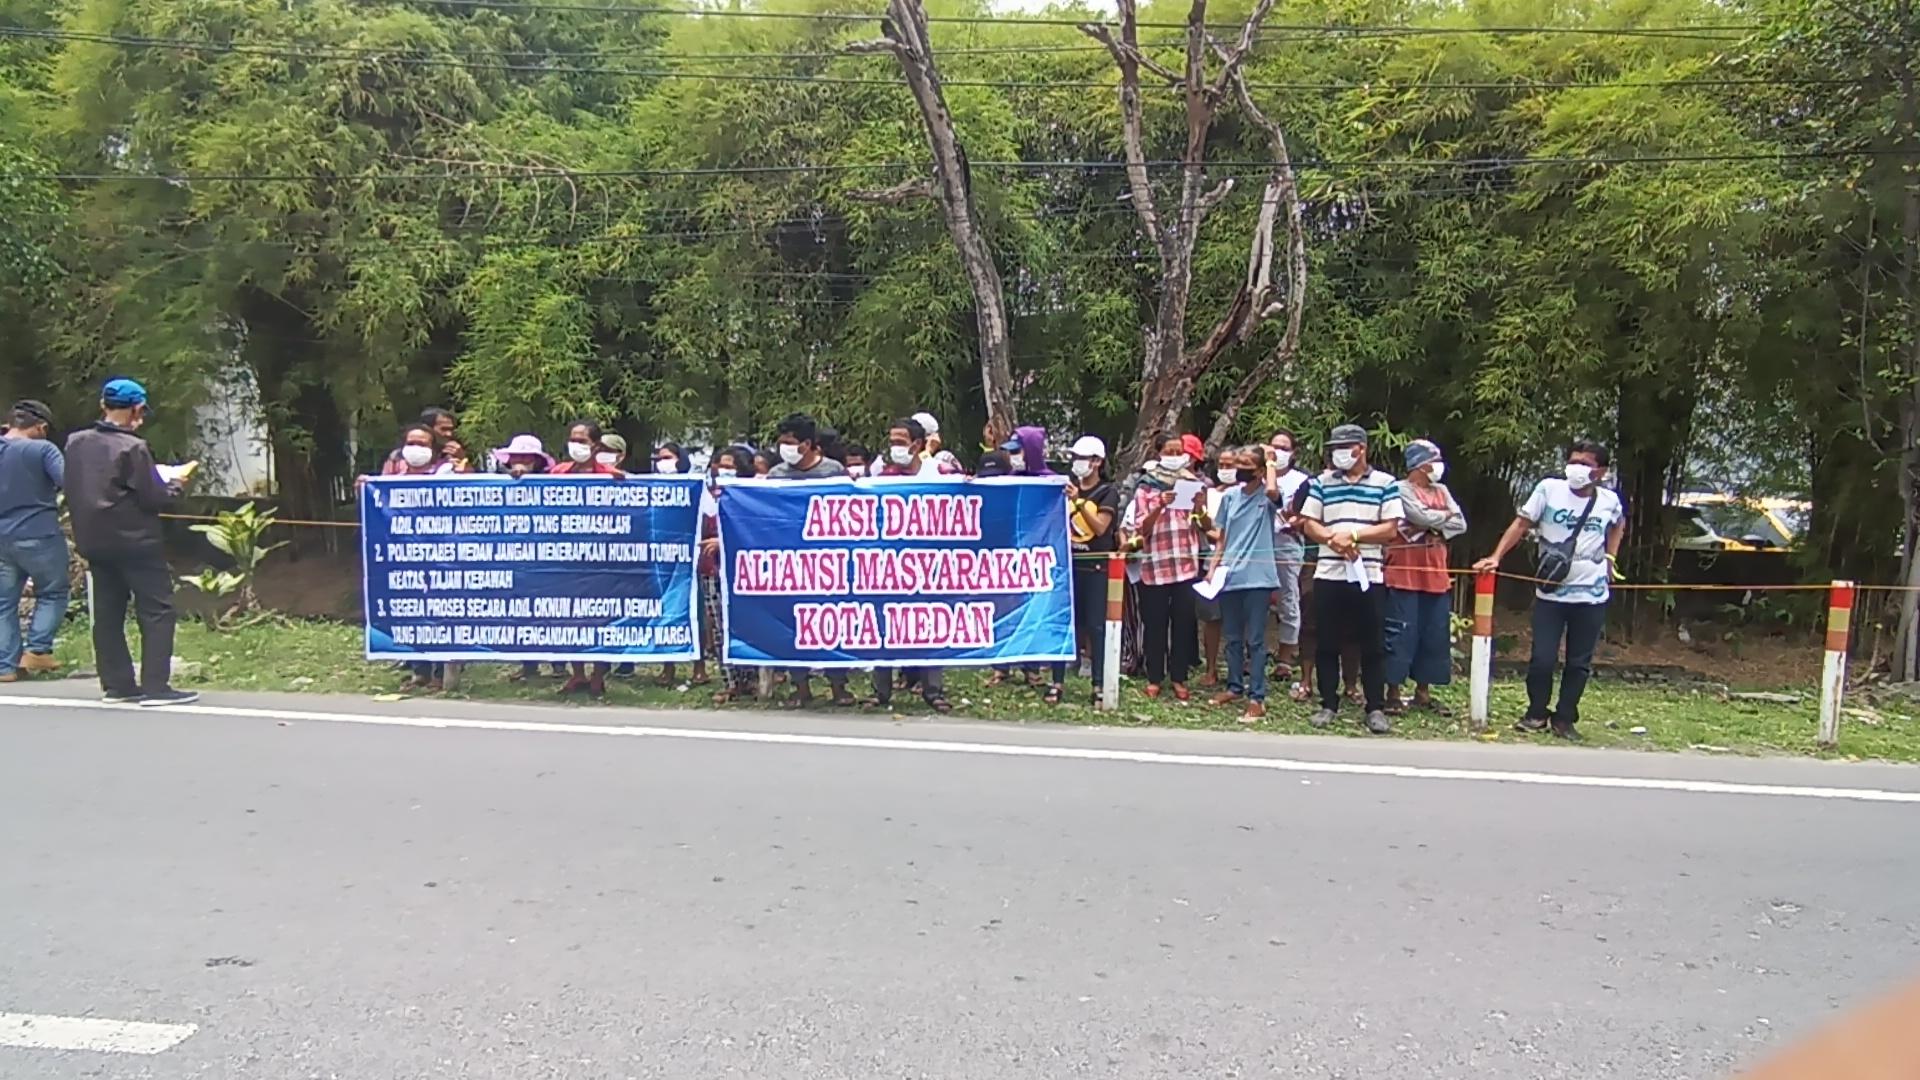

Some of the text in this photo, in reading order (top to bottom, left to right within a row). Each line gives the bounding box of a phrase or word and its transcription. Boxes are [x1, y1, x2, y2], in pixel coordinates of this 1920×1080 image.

[389, 487, 434, 508] MEMINTA
[436, 486, 503, 507] POLRESTABES
[505, 486, 541, 506] MEDAN
[543, 486, 584, 506] SEGERA
[586, 486, 649, 507] MEMPROSES
[650, 486, 691, 506] SECARA
[390, 515, 631, 534] ADIL OKNUM ANGGOTA DPRD YANG BERMASALAH
[805, 497, 981, 537] AKSI DAMAI
[374, 542, 692, 562] 2. POLRESTABES MEDAN JANGAN MENERAPKAN HUKUM TUMPUL
[389, 570, 513, 594] KEATAS, TAJAM KEBAWAH
[736, 551, 1053, 591] ALIANSI MASYARAKAT
[389, 598, 425, 617] SEGERA
[427, 598, 465, 617] PROSES
[467, 598, 506, 617] SECARA
[508, 598, 532, 617] ADIL
[533, 597, 571, 617] OKNUM
[572, 598, 623, 618] ANGGOTA
[624, 598, 662, 617] DEWAN
[391, 626, 692, 646] YANG DIDUGA MELAKUKAN PENGANIAYAAN TERHADAP WARGA
[797, 605, 991, 646] KOTA MEDAN
